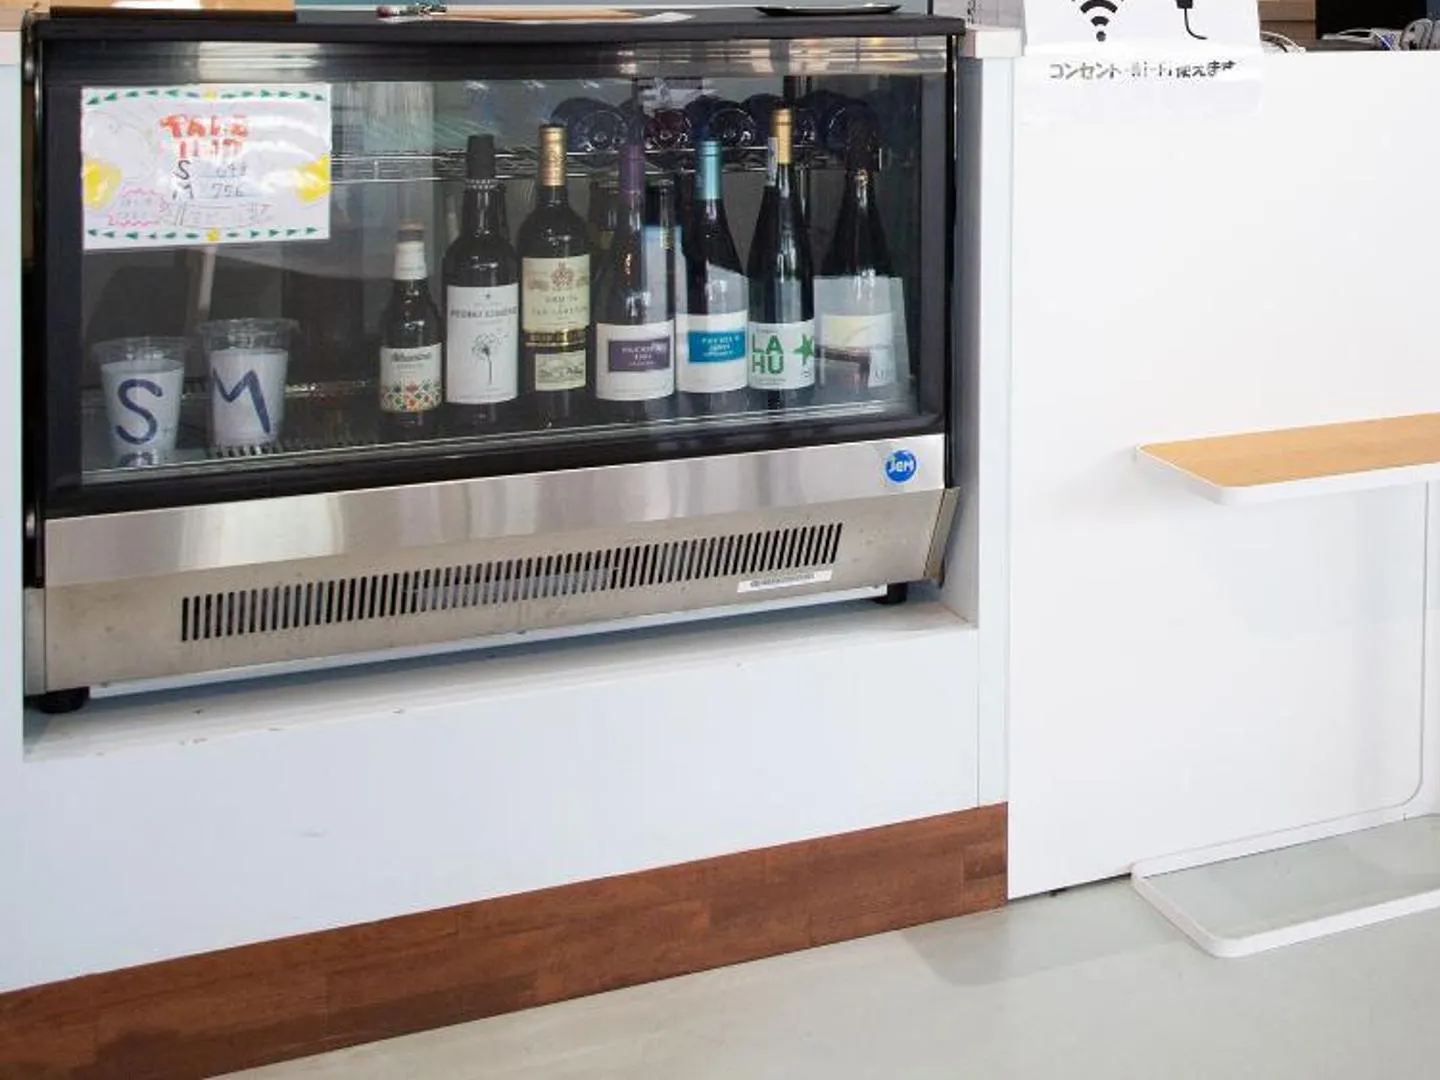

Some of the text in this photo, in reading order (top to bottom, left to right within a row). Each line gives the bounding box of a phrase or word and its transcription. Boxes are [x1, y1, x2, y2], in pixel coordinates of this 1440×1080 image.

[175, 160, 191, 180] S
[752, 333, 784, 354] LA
[115, 378, 163, 445] S
[211, 368, 272, 434] M
